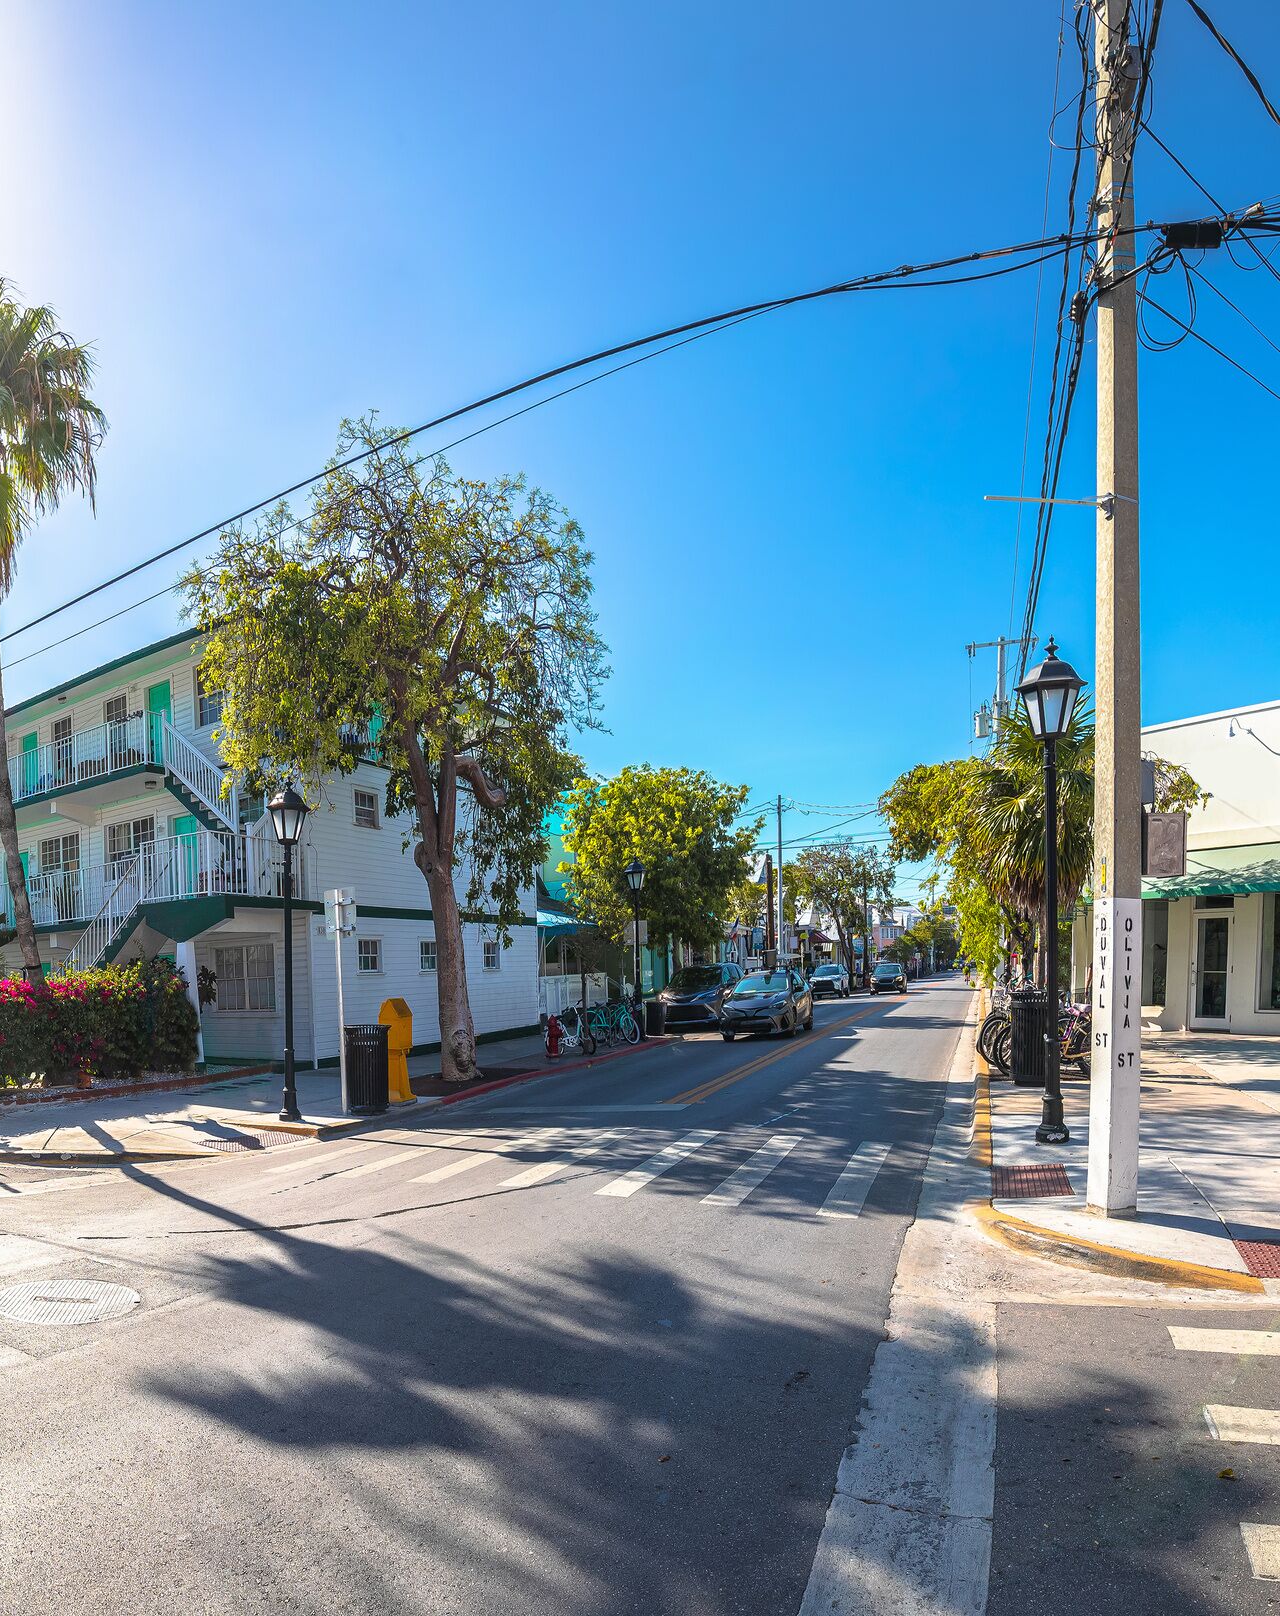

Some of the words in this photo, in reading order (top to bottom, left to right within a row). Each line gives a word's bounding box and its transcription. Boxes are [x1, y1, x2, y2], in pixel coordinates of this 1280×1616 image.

[1099, 917, 1107, 1009] DUVAL
[1095, 1033, 1108, 1047] ST
[1117, 1052, 1134, 1067] ST
